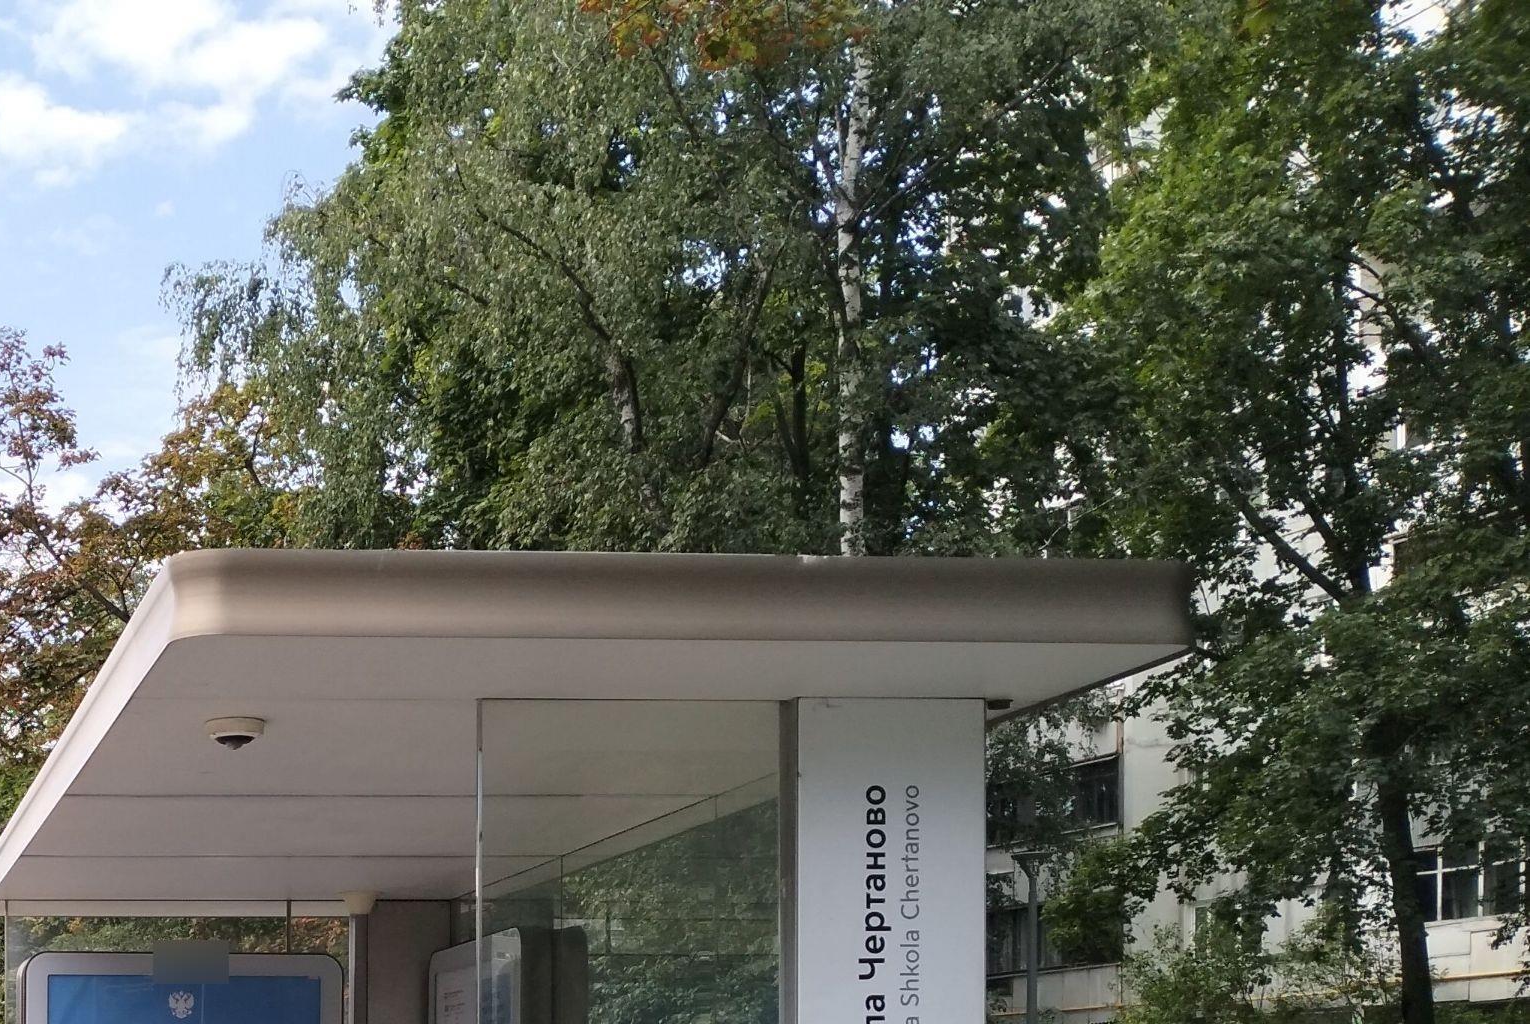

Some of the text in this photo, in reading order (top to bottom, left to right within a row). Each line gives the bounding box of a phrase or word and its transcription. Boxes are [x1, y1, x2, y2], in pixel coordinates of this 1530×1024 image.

[858, 785, 892, 980] Чертаново
[899, 784, 920, 920] Chertanovo
[899, 930, 920, 1006] Shkola
